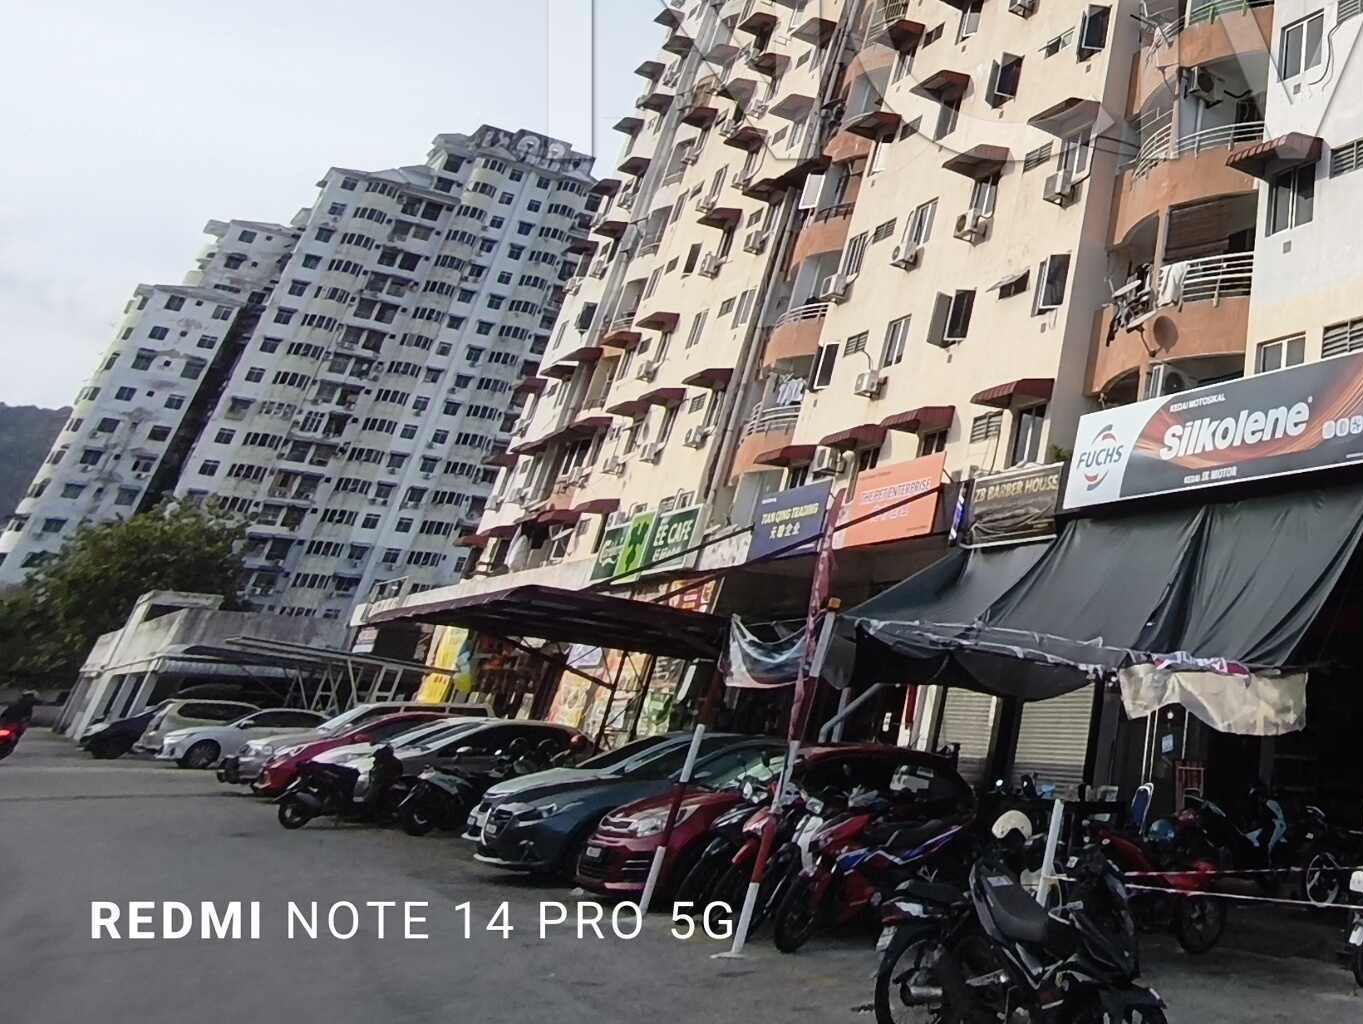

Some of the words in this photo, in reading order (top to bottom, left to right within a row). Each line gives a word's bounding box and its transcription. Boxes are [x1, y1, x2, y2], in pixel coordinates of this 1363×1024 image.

[1159, 402, 1310, 461] Silkolene
[1077, 444, 1124, 470] FUCHS
[667, 520, 694, 545] CAFE
